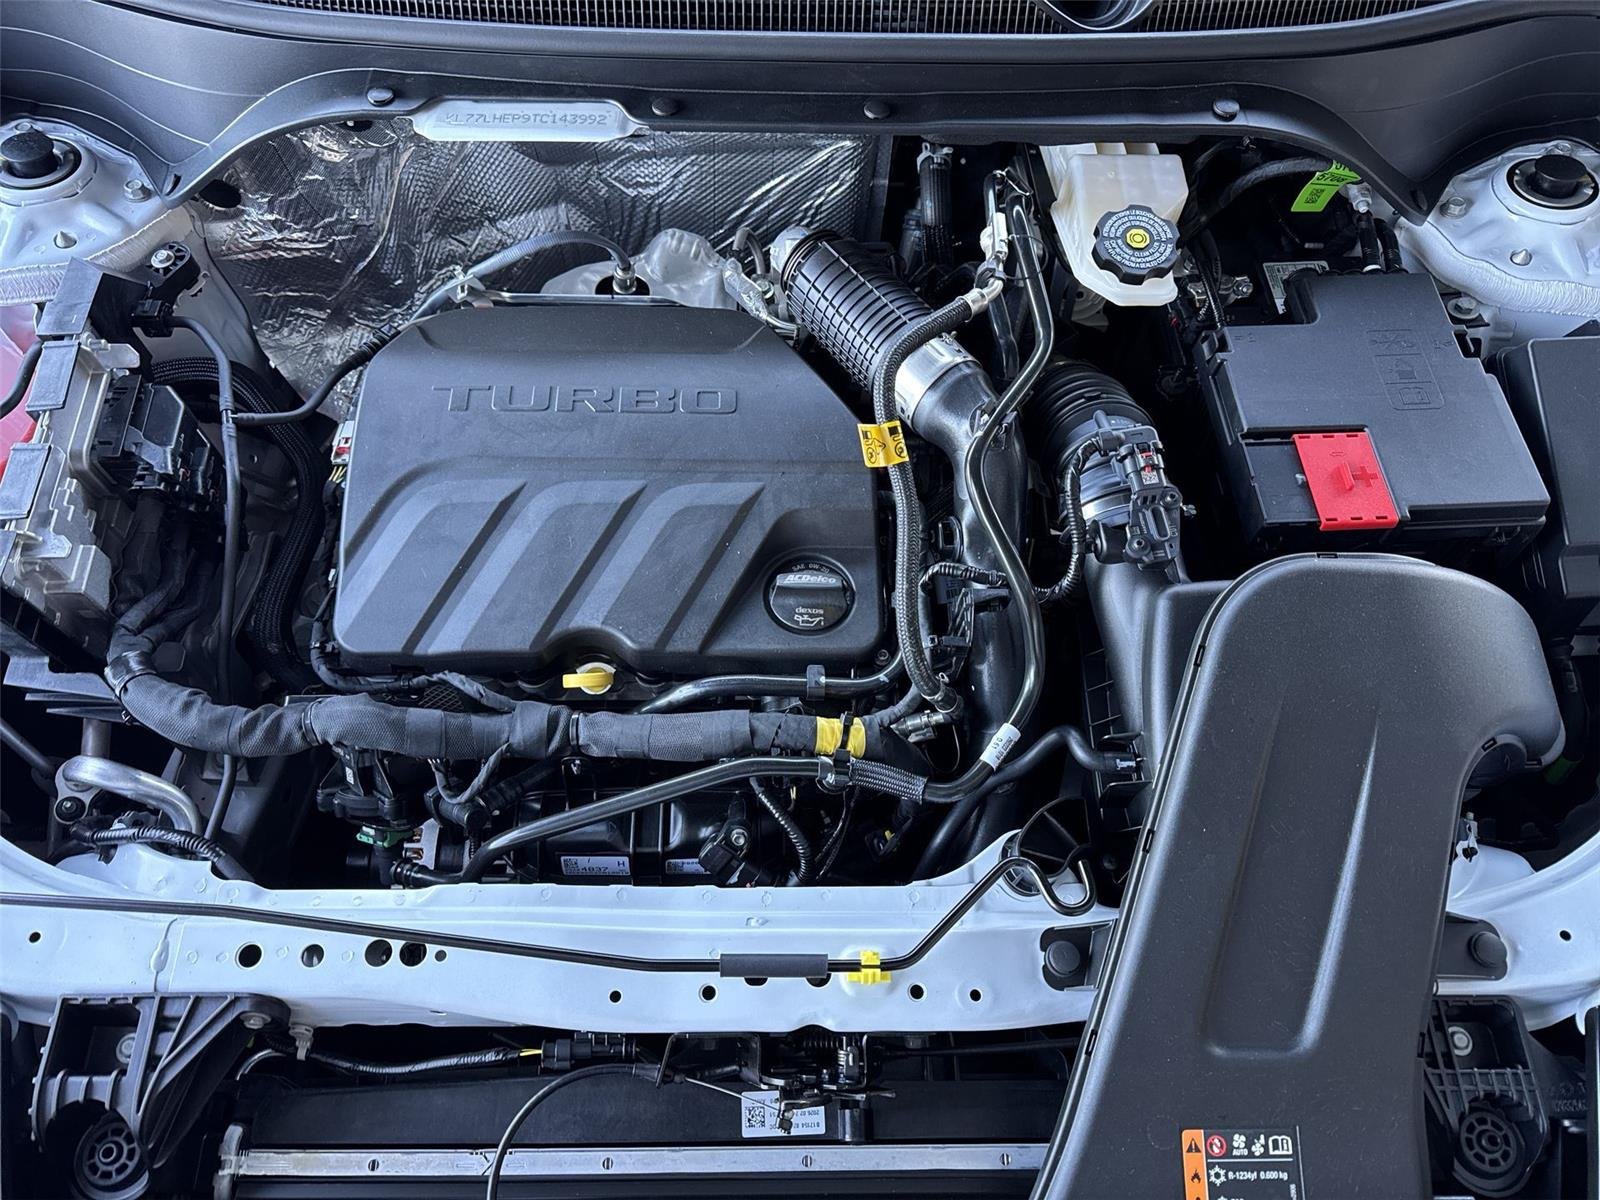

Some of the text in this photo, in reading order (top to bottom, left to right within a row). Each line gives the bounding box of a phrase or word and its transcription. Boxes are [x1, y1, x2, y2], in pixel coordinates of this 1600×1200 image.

[432, 385, 738, 414] TURBO
[784, 575, 836, 584] ACDelco
[1228, 1171, 1288, 1181] R-1234yf 0.600 kg
